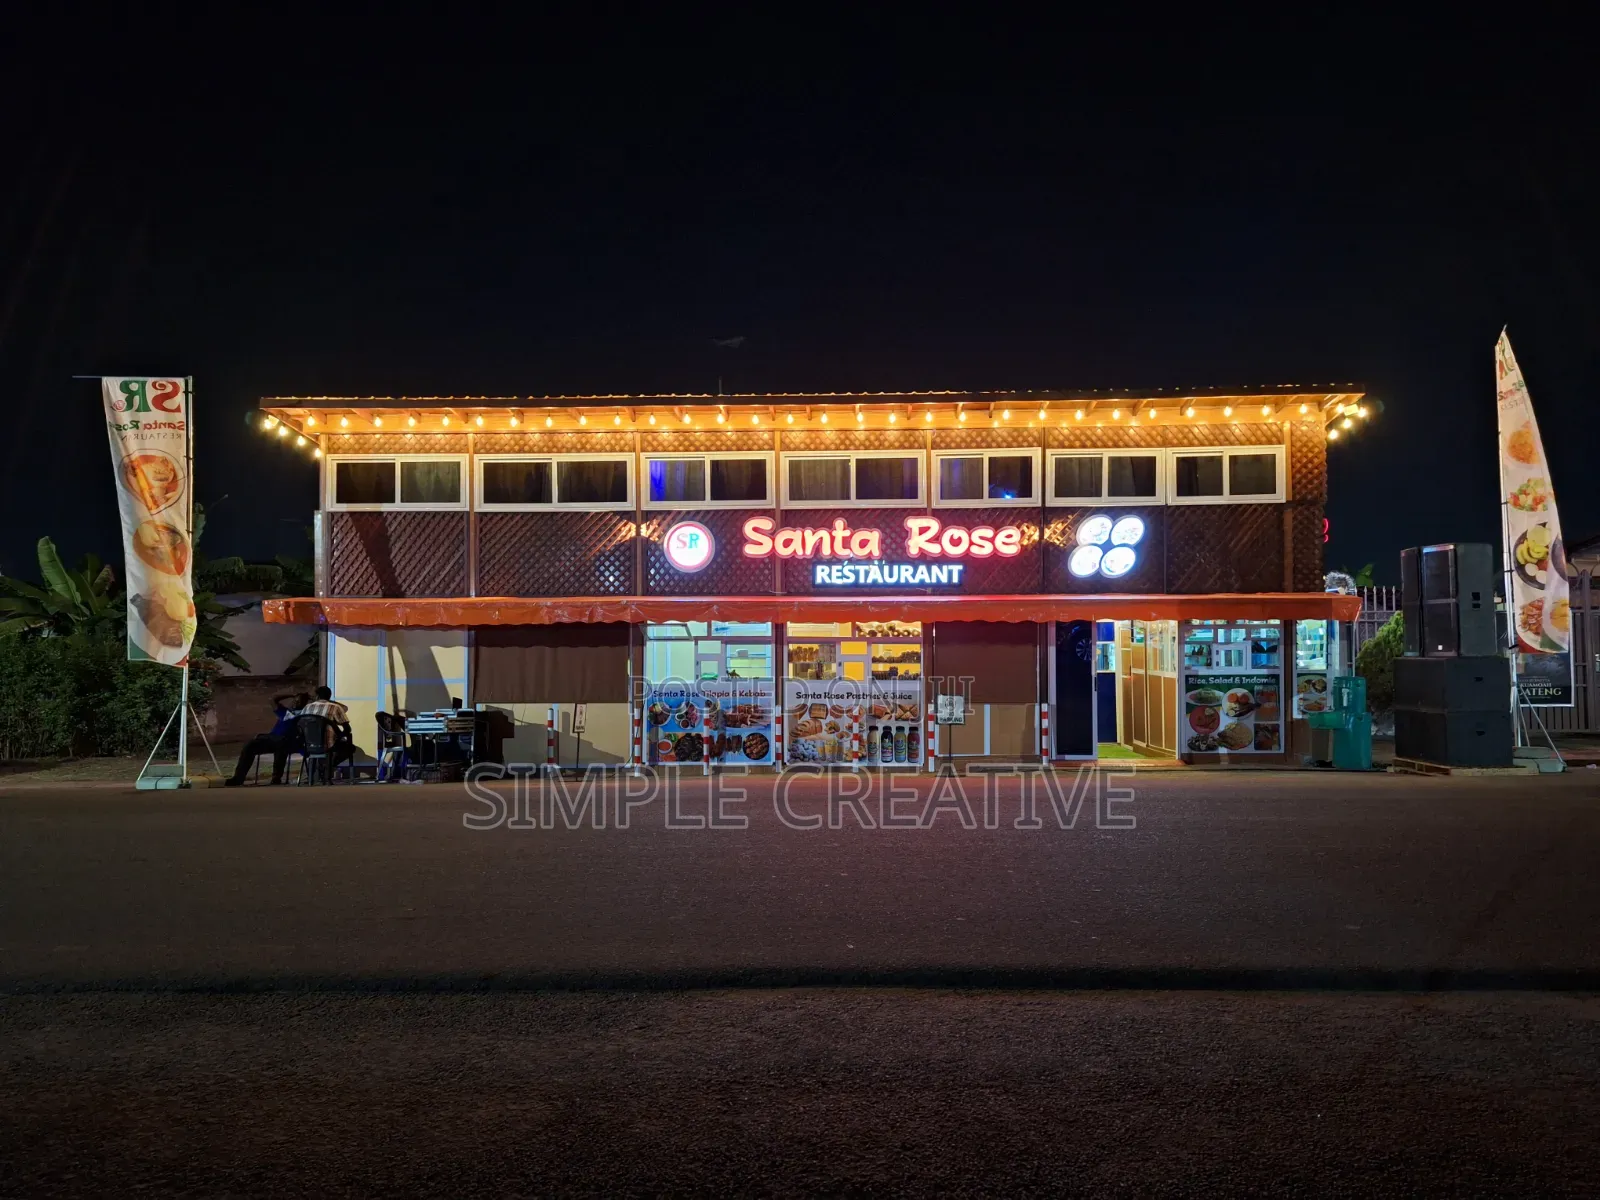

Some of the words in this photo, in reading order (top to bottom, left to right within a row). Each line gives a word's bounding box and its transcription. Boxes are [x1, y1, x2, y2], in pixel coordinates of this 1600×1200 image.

[676, 532, 700, 549] SR
[742, 516, 882, 558] Santa
[902, 516, 1021, 558] Rose
[653, 690, 678, 698] Santa
[679, 690, 699, 698] Rose
[701, 690, 730, 699] Tilapia
[738, 690, 766, 698] Kebab
[795, 692, 822, 700] Santa
[823, 692, 845, 700] Rose
[846, 692, 880, 700] Pastries
[882, 692, 890, 700] &
